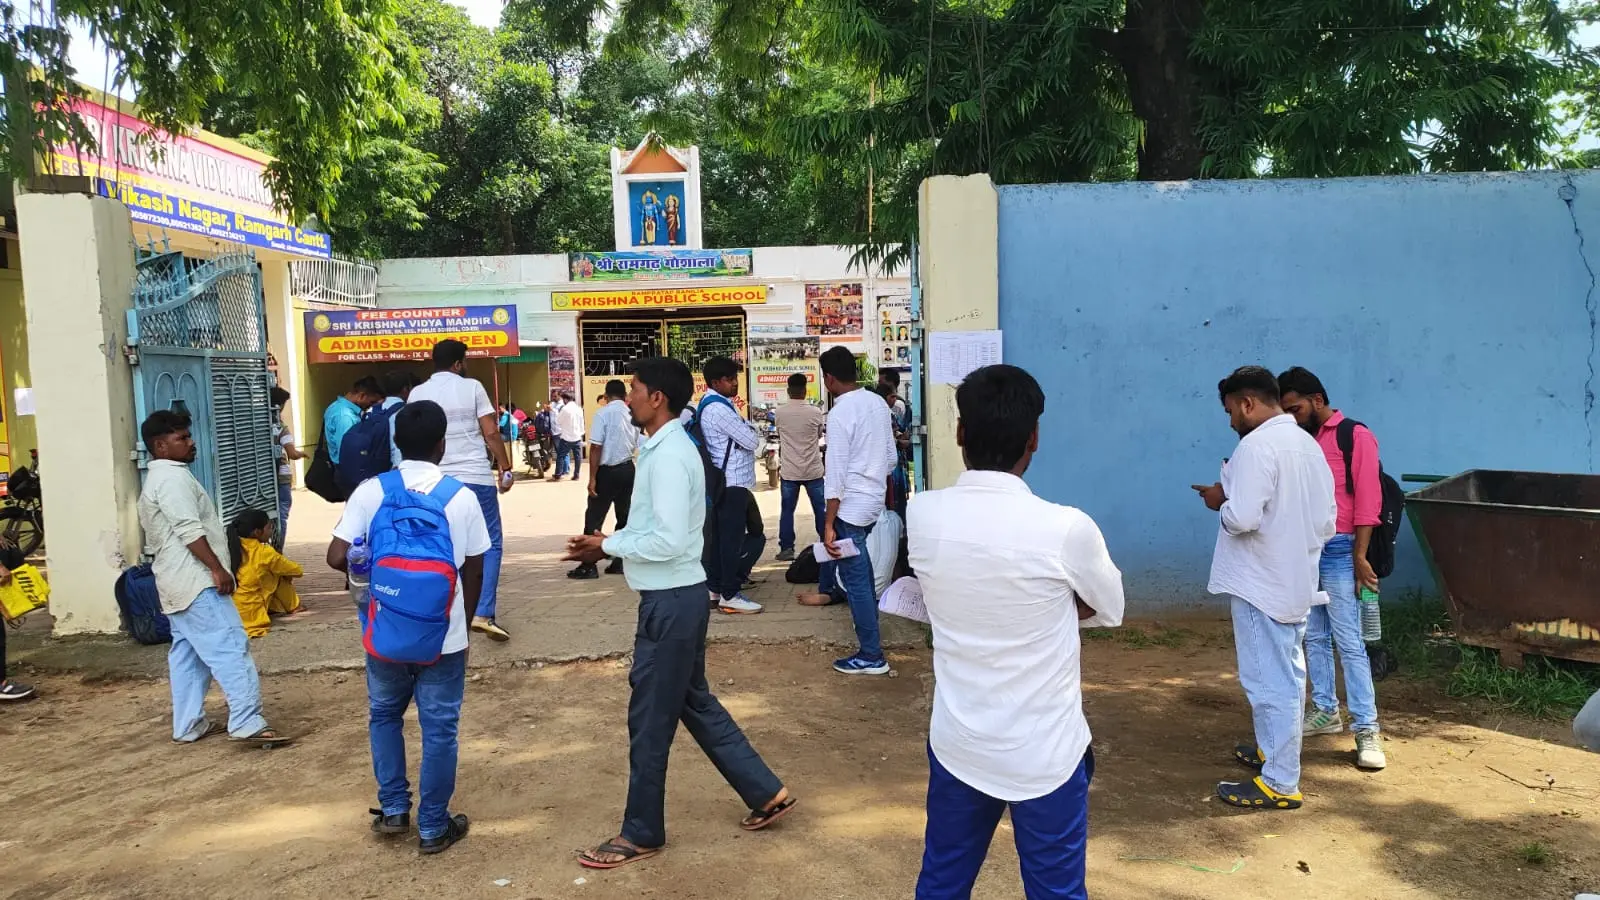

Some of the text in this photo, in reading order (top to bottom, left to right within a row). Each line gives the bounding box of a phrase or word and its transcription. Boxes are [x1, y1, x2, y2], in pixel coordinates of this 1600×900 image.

[190, 149, 236, 198] VIDYA
[105, 180, 327, 249] Vikash Nagar, Ramgarh Cantt.
[596, 256, 614, 271] श्री
[571, 291, 765, 307] KRISHNA PUBLIC SCHOOL
[361, 309, 461, 319] FEE COUNTER
[332, 316, 492, 330] SRI KRISHNA VIDYA MANDIR
[330, 335, 497, 351] ADMISSION PEN
[356, 353, 384, 361] CLASS
[389, 352, 407, 360] Nur.
[373, 582, 401, 597] safari
